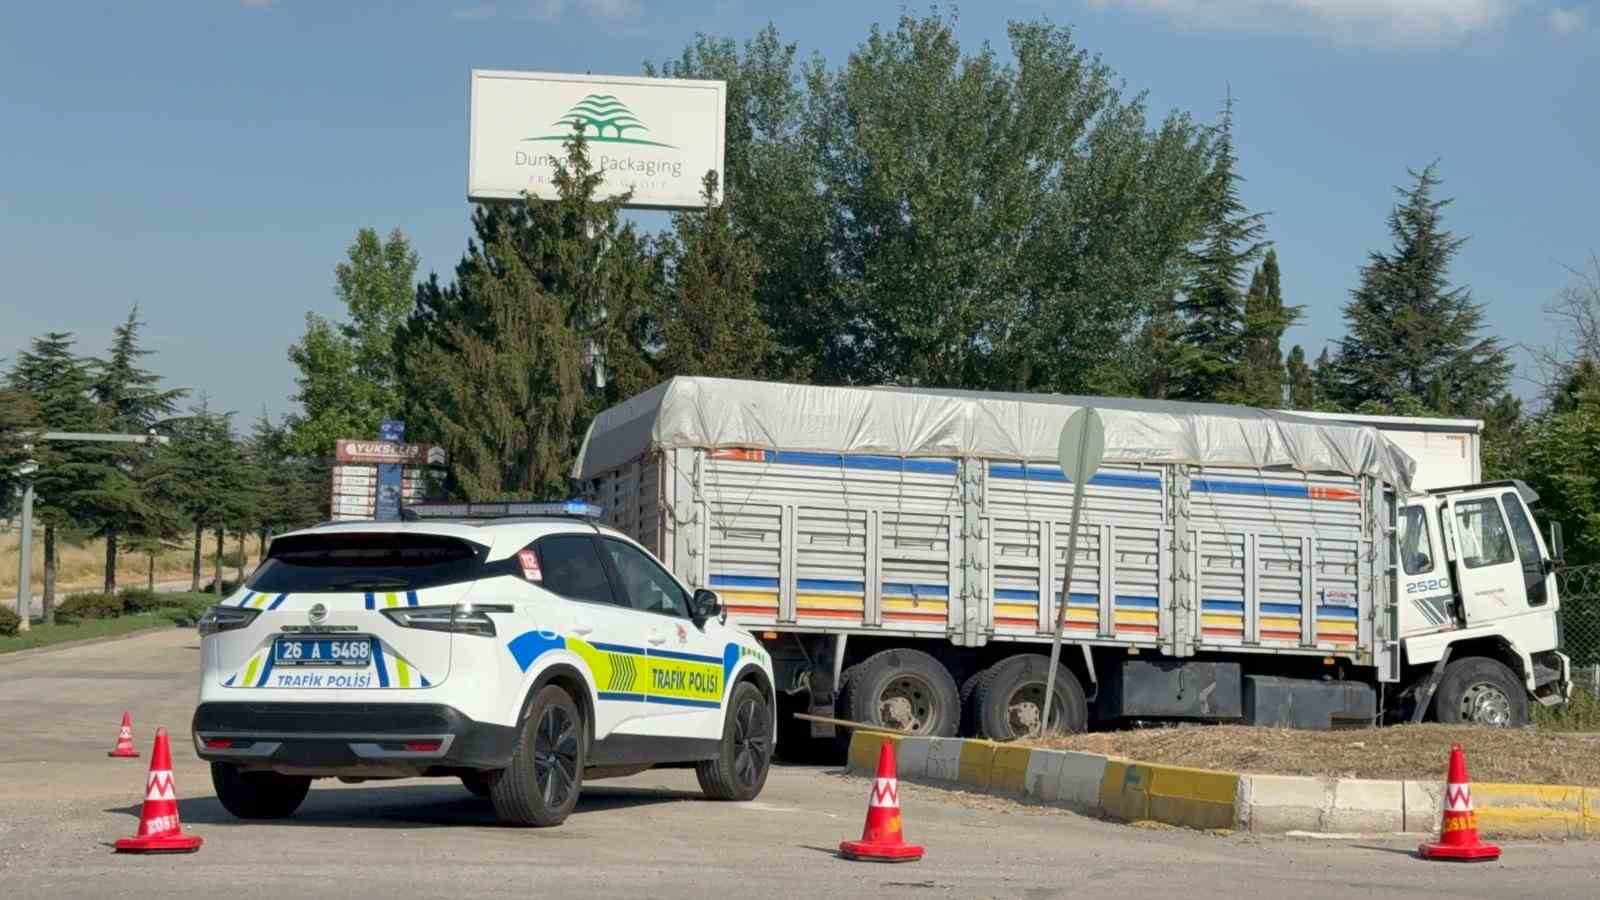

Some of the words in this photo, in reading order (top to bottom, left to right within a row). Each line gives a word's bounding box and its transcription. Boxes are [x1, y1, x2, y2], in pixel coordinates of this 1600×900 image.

[515, 151, 593, 171] Dunap
[600, 156, 682, 177] Packaging
[1407, 578, 1449, 593] 2520
[283, 642, 302, 658] 26
[311, 642, 321, 658] A
[331, 642, 369, 658] 5468
[278, 673, 323, 686] TRAFİK
[327, 672, 371, 687] POLİSİ
[652, 666, 686, 690] TRAFİK
[689, 669, 719, 693] POLİSİ
